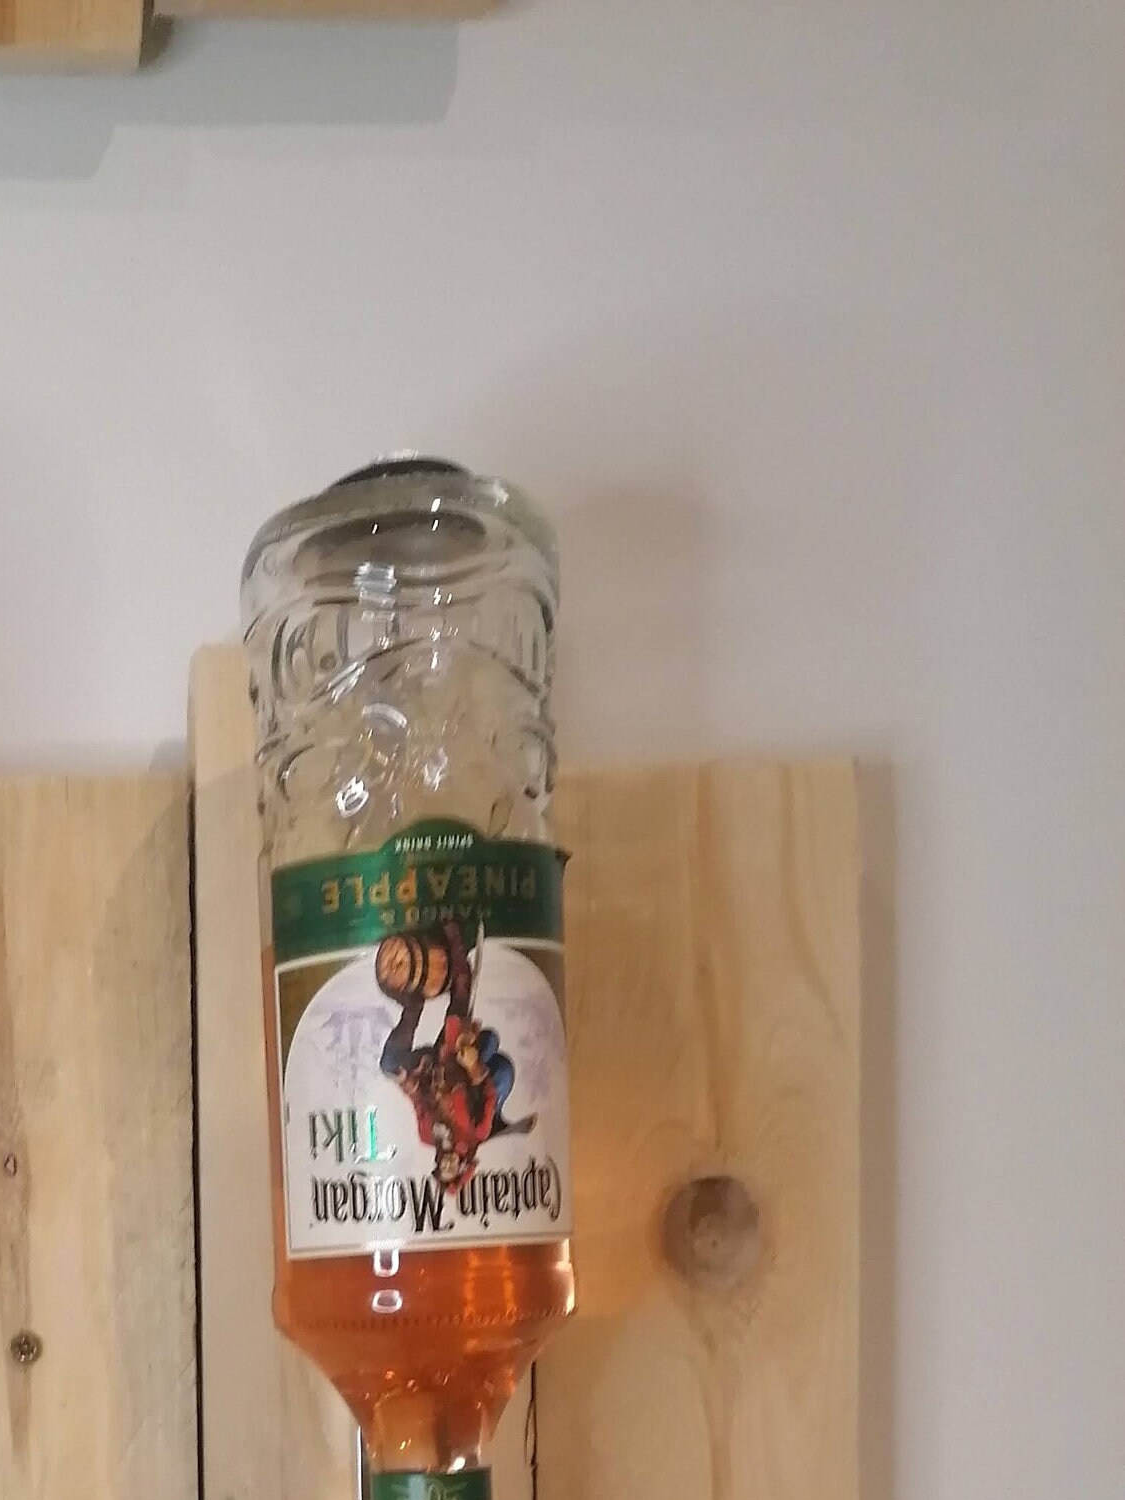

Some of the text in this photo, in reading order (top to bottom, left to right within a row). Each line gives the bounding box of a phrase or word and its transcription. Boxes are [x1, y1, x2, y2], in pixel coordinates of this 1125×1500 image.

[320, 863, 537, 914] PINEAPPLE
[308, 1105, 398, 1164] Tiki
[311, 1155, 563, 1233] Captain Morgan
